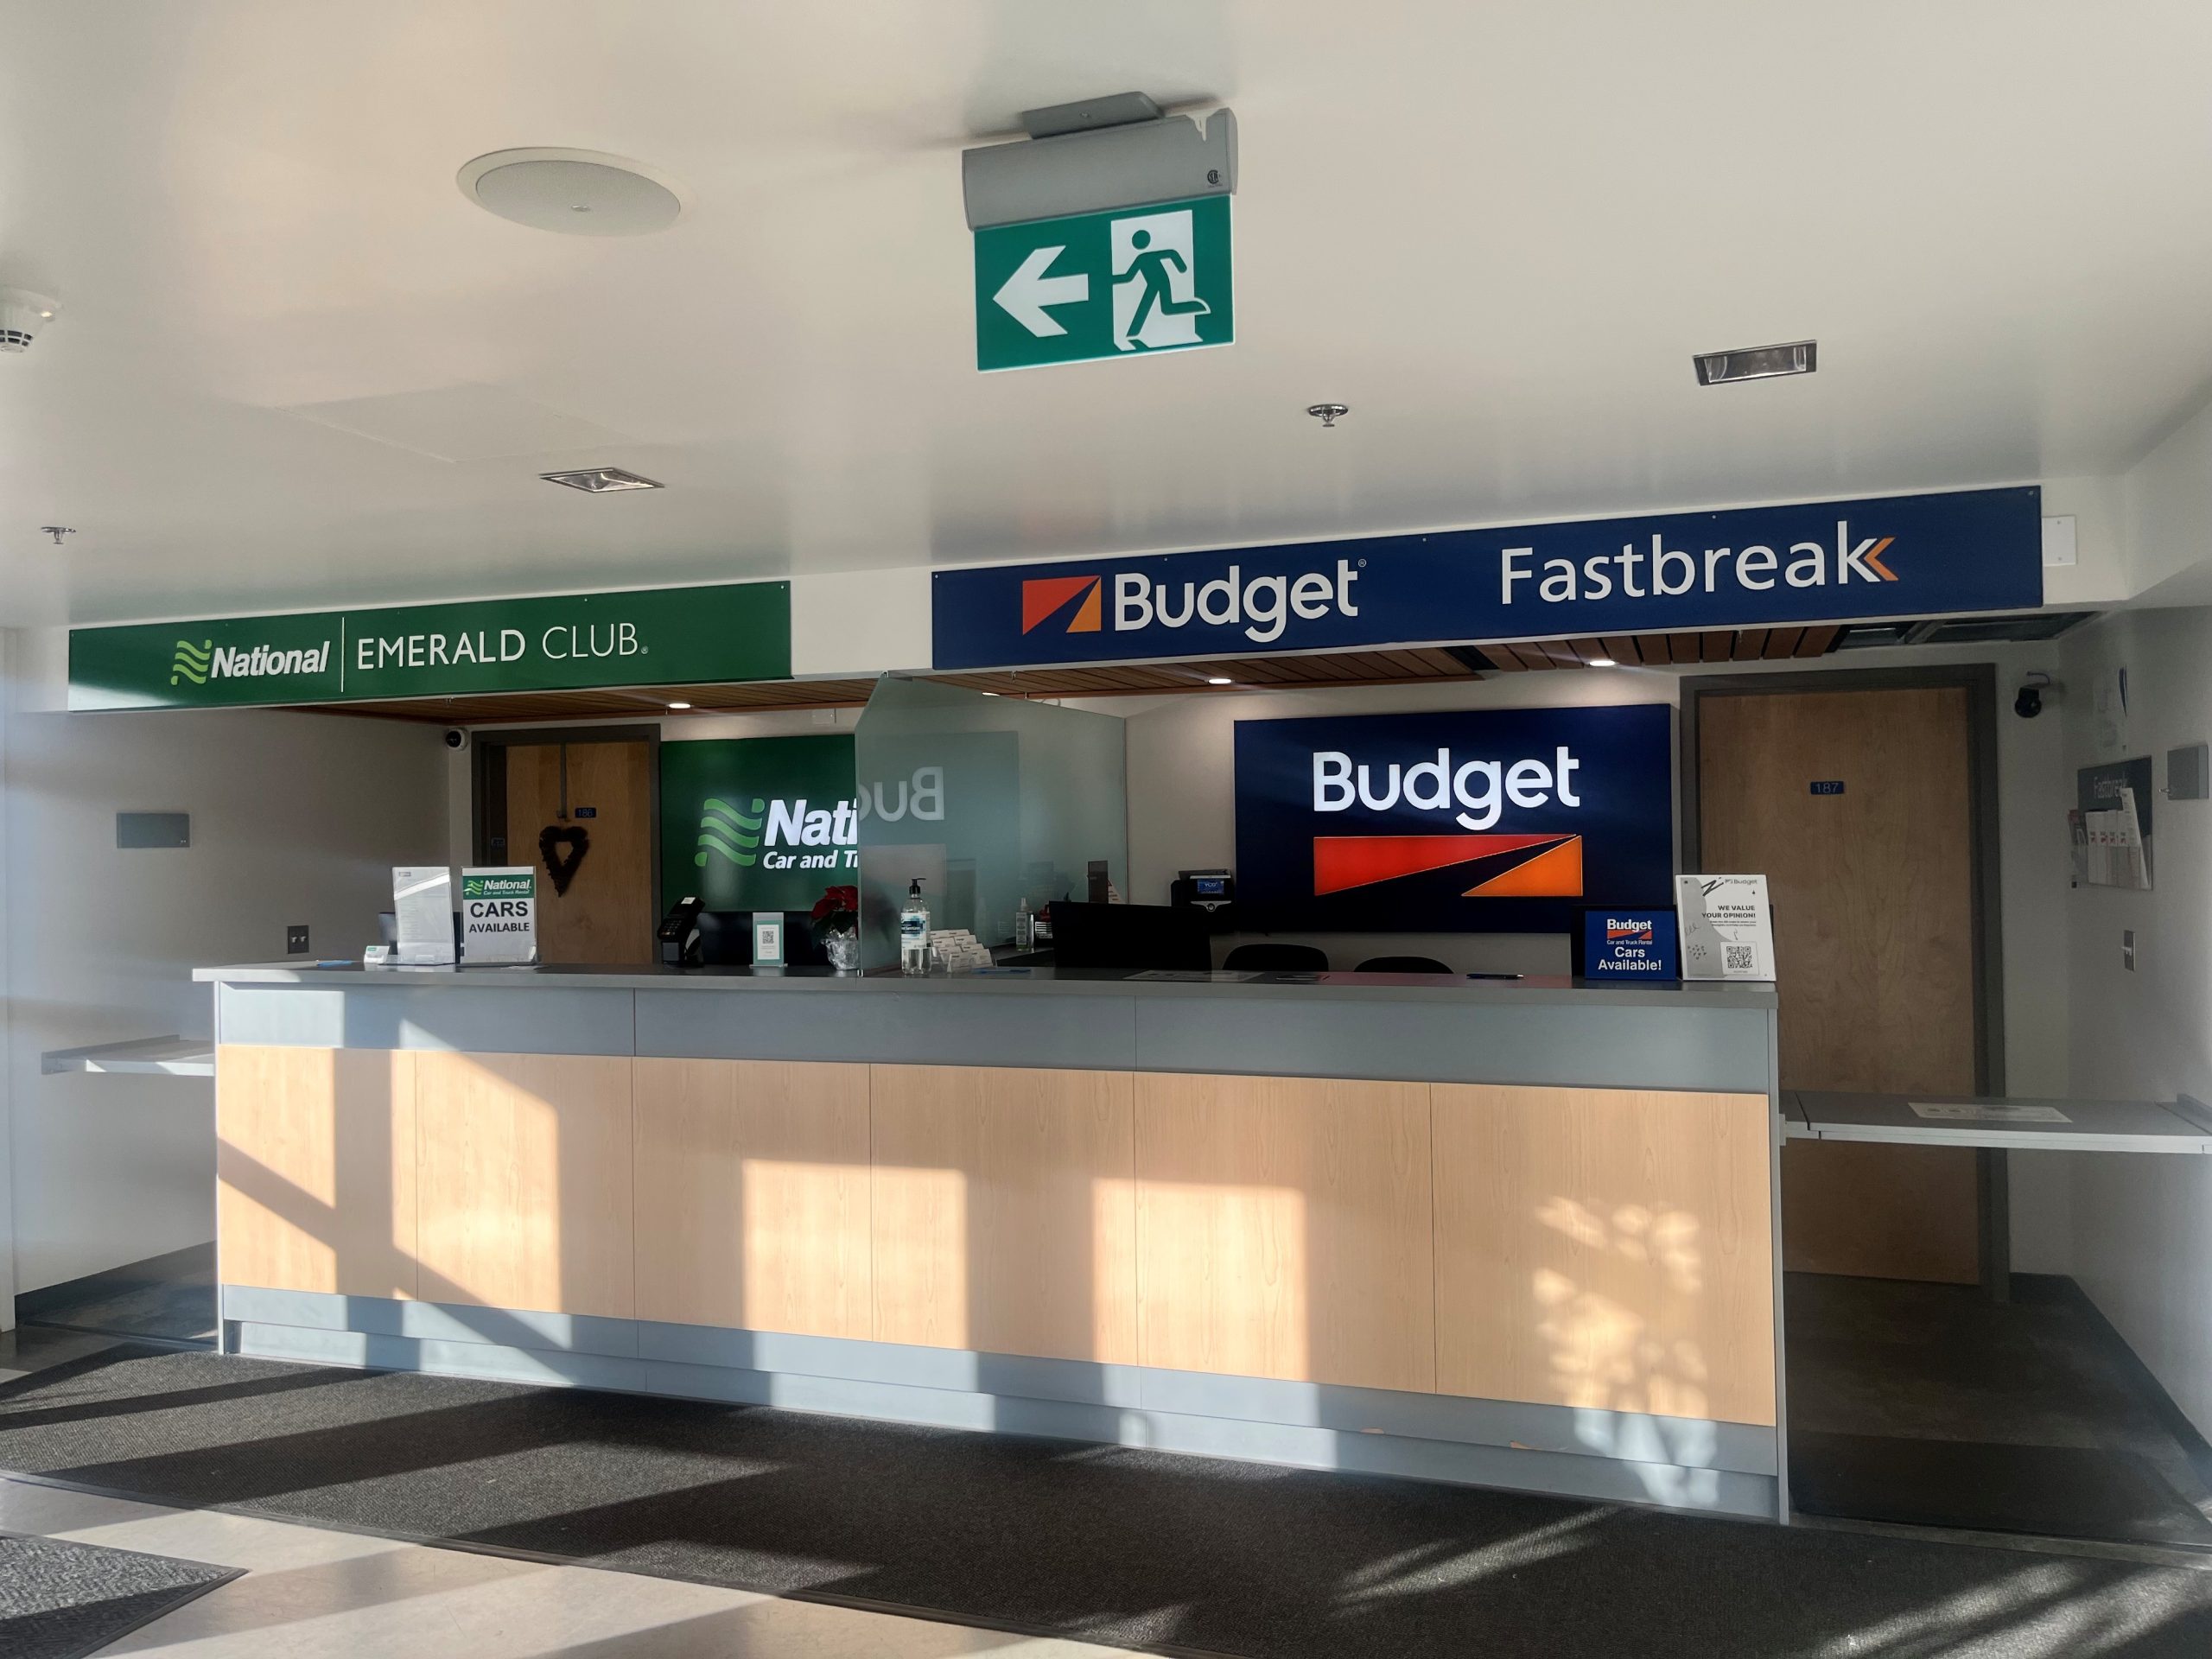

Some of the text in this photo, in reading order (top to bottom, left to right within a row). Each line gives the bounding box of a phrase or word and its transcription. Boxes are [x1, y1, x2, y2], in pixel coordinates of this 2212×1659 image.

[1502, 521, 1881, 604] Fastbreak
[1115, 557, 1359, 644] Budget
[358, 622, 638, 670] EMERALD CLUB
[211, 640, 330, 678] National
[1313, 746, 1580, 831] Budget
[763, 850, 797, 869] Car
[799, 849, 839, 869] and
[484, 879, 531, 891] National
[470, 900, 529, 918] CARS
[468, 922, 530, 933] AVAILABLE
[1606, 918, 1652, 932] Budget
[1614, 946, 1645, 958] Cars
[1598, 959, 1662, 971] Available!
